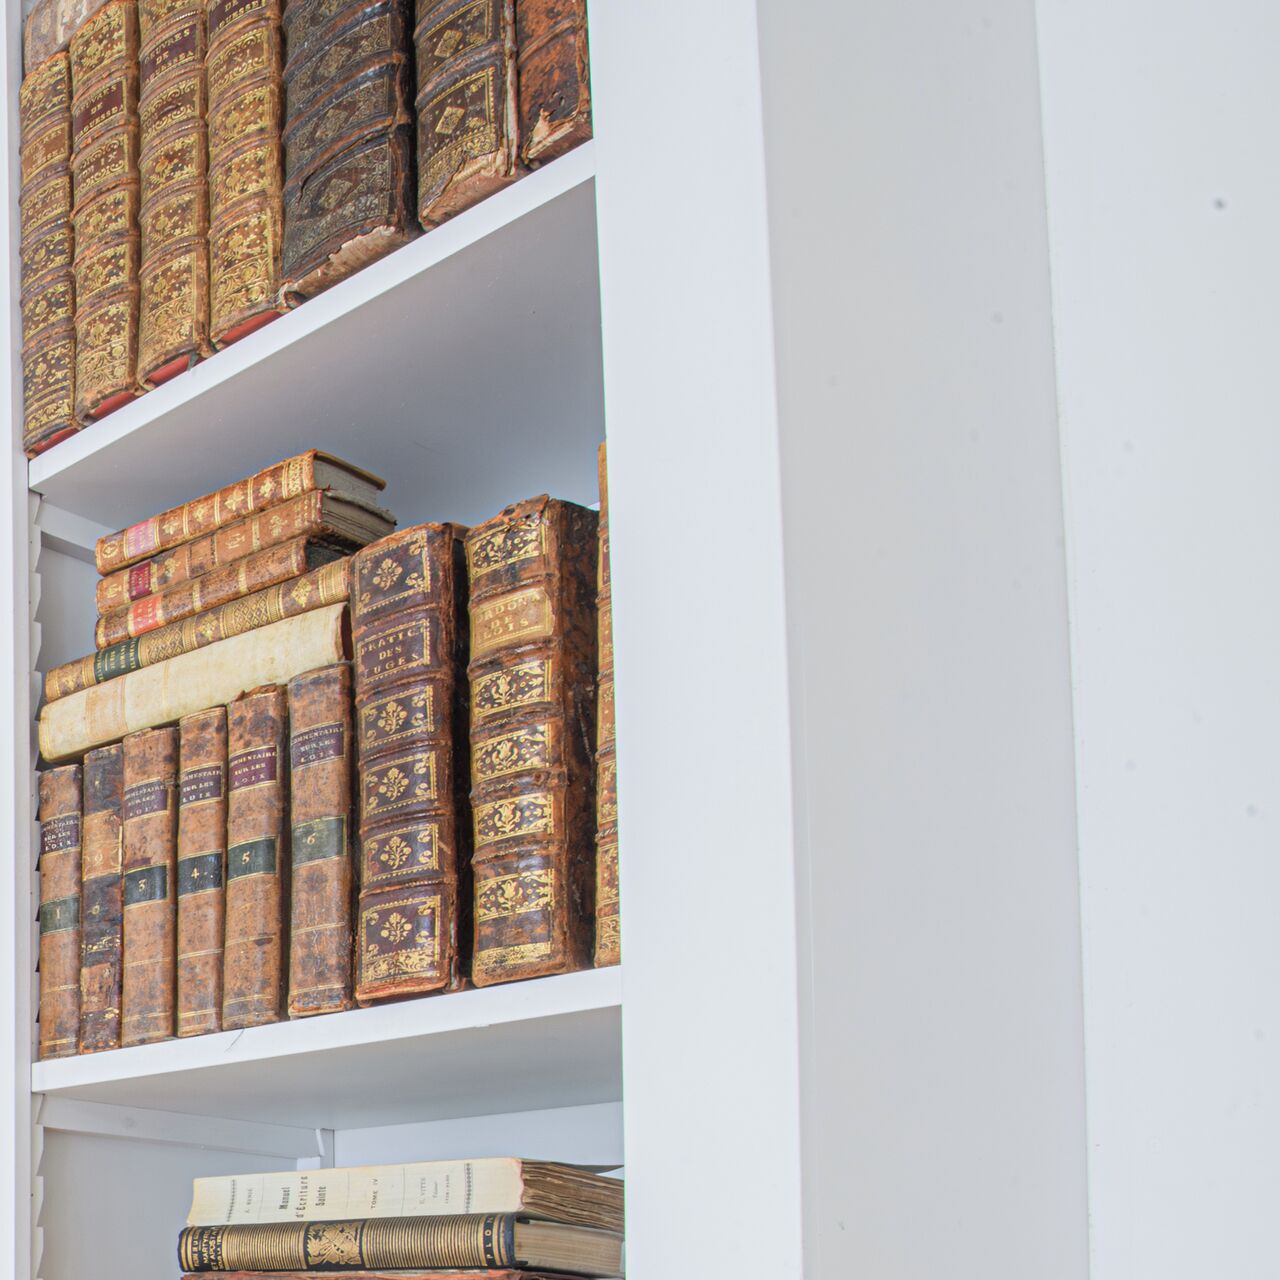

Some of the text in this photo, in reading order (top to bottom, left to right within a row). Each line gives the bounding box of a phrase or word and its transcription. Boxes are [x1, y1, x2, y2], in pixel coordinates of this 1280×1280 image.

[307, 833, 316, 845] 6
[241, 852, 250, 864] 5
[191, 868, 200, 879] 4
[138, 879, 145, 891] 3
[279, 1186, 290, 1210] Manuel
[315, 1185, 326, 1206] Sainte
